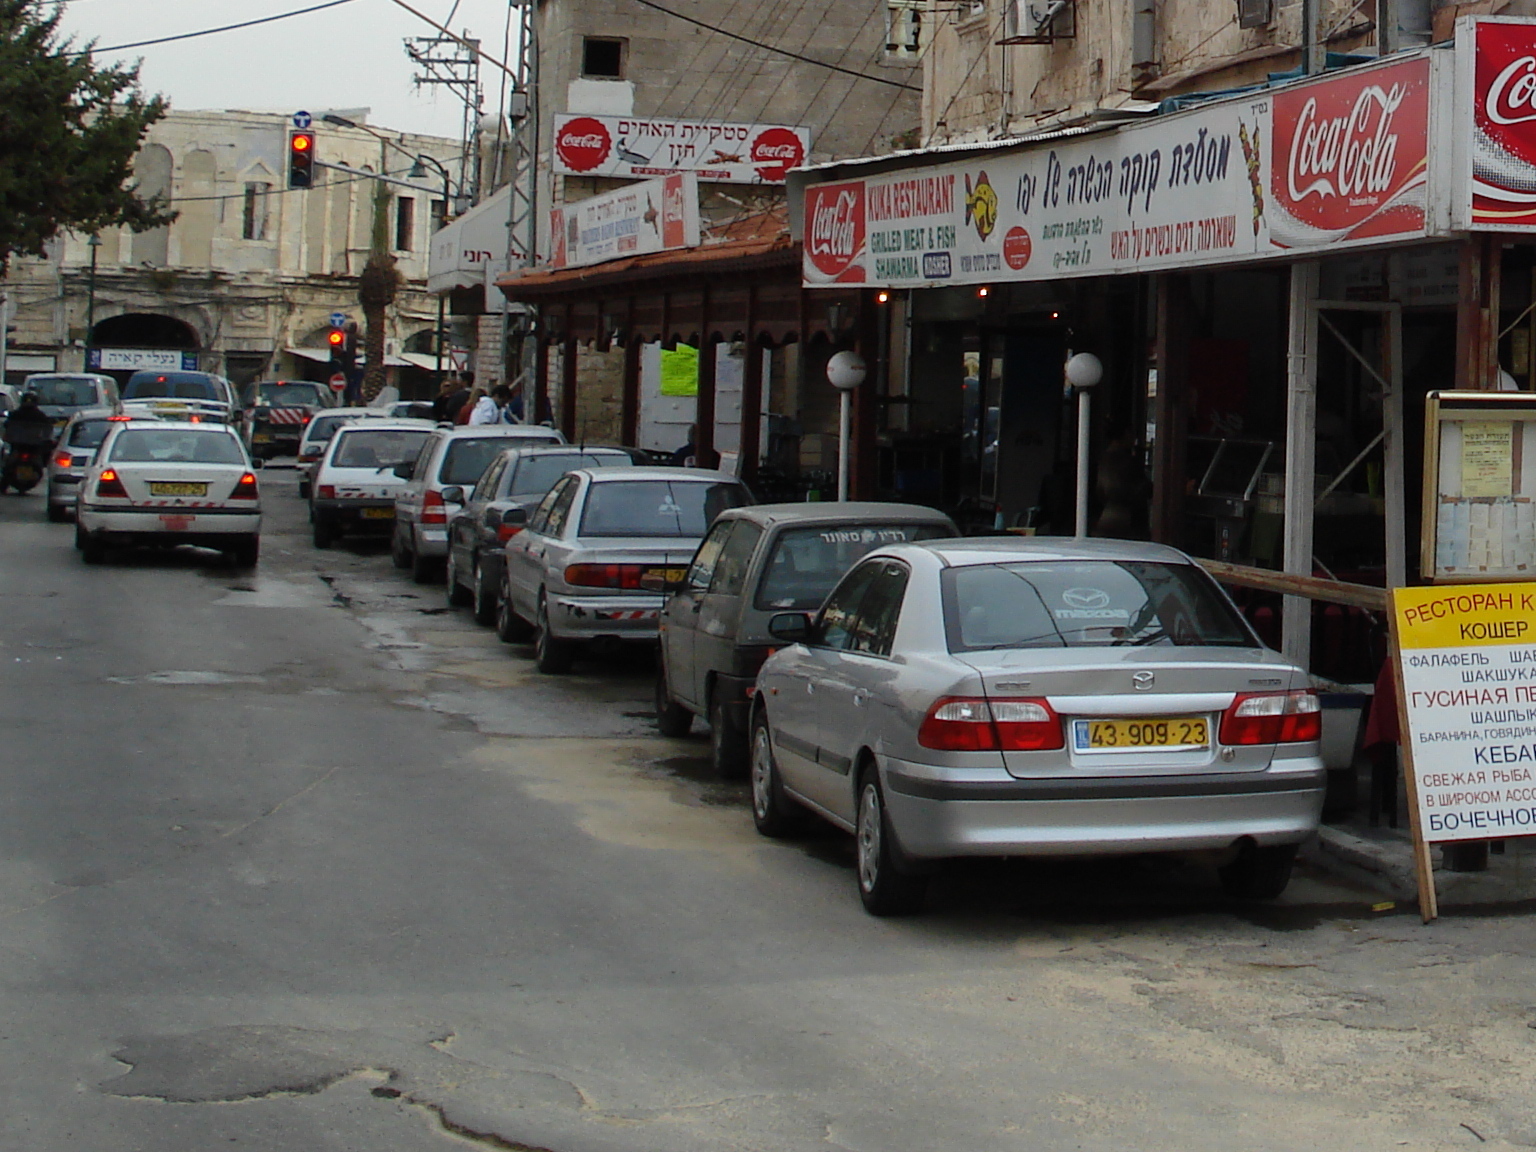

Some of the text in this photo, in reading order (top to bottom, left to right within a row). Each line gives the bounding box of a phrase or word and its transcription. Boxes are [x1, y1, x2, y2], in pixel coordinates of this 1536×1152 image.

[617, 120, 748, 145] סטקיית האחים
[1288, 81, 1407, 202] Coca-Cola
[668, 143, 696, 163] חזן
[1016, 127, 1231, 215] מסעדת קוקה הכשרה של יפו
[868, 174, 956, 222] KUKA RESTAURANT
[871, 225, 956, 254] GRILLED MEAT & FISH
[1111, 229, 1129, 259] האש
[1132, 220, 1143, 263] על
[876, 256, 919, 279] SHAWARMA
[924, 254, 950, 276] KOSHER
[1404, 593, 1514, 626] РЕСТОРАН
[1460, 621, 1529, 640] КОШЕР
[1409, 653, 1489, 667] ФАЛАФЕЛЬ
[1412, 687, 1508, 708] ГУСИНАЯ
[1423, 771, 1486, 787] СВЕЖАЯ
[1493, 768, 1531, 783] РЫБА
[1426, 794, 1435, 807] В
[1438, 791, 1500, 807] ШИРОКОМ
